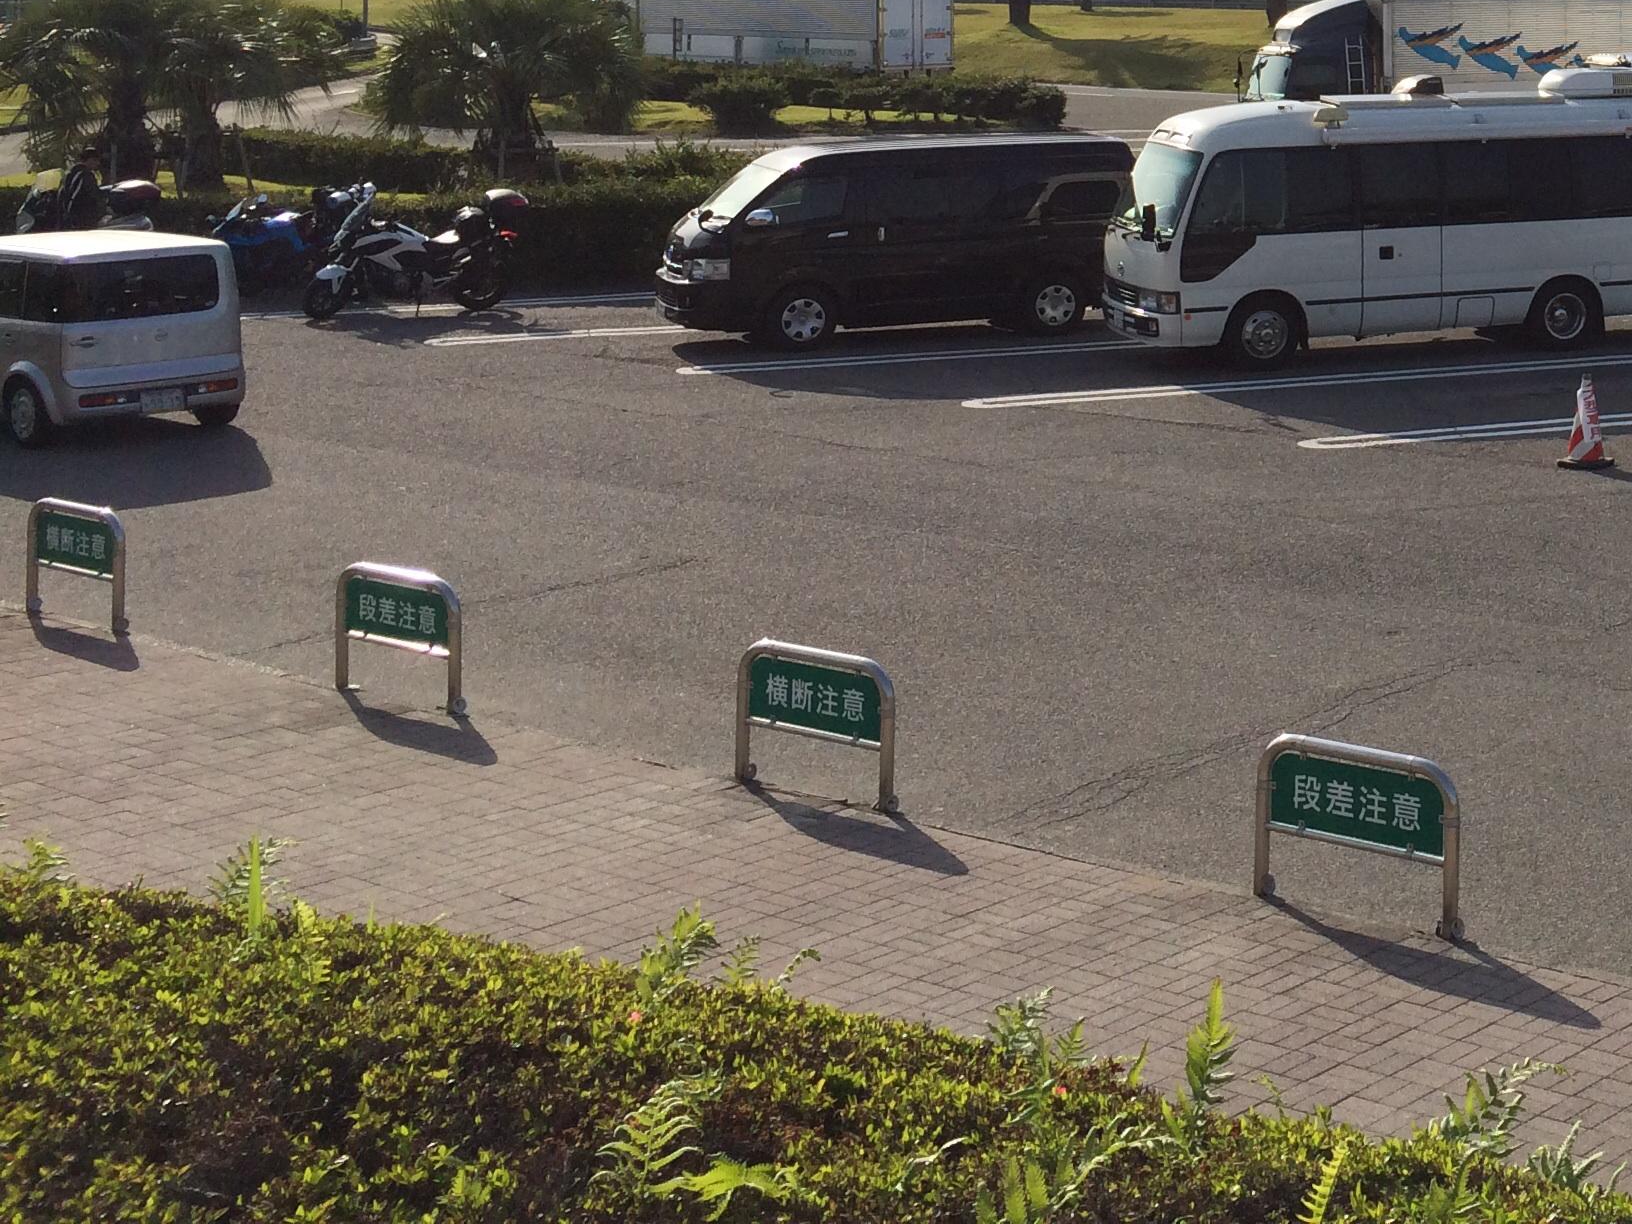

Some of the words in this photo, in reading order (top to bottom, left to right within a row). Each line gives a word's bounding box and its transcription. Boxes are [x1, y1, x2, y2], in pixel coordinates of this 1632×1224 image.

[46, 523, 106, 560] 横断注意
[358, 593, 436, 635] 段差注意
[765, 673, 865, 722] 横断注意
[1292, 774, 1422, 831] 段差注意
